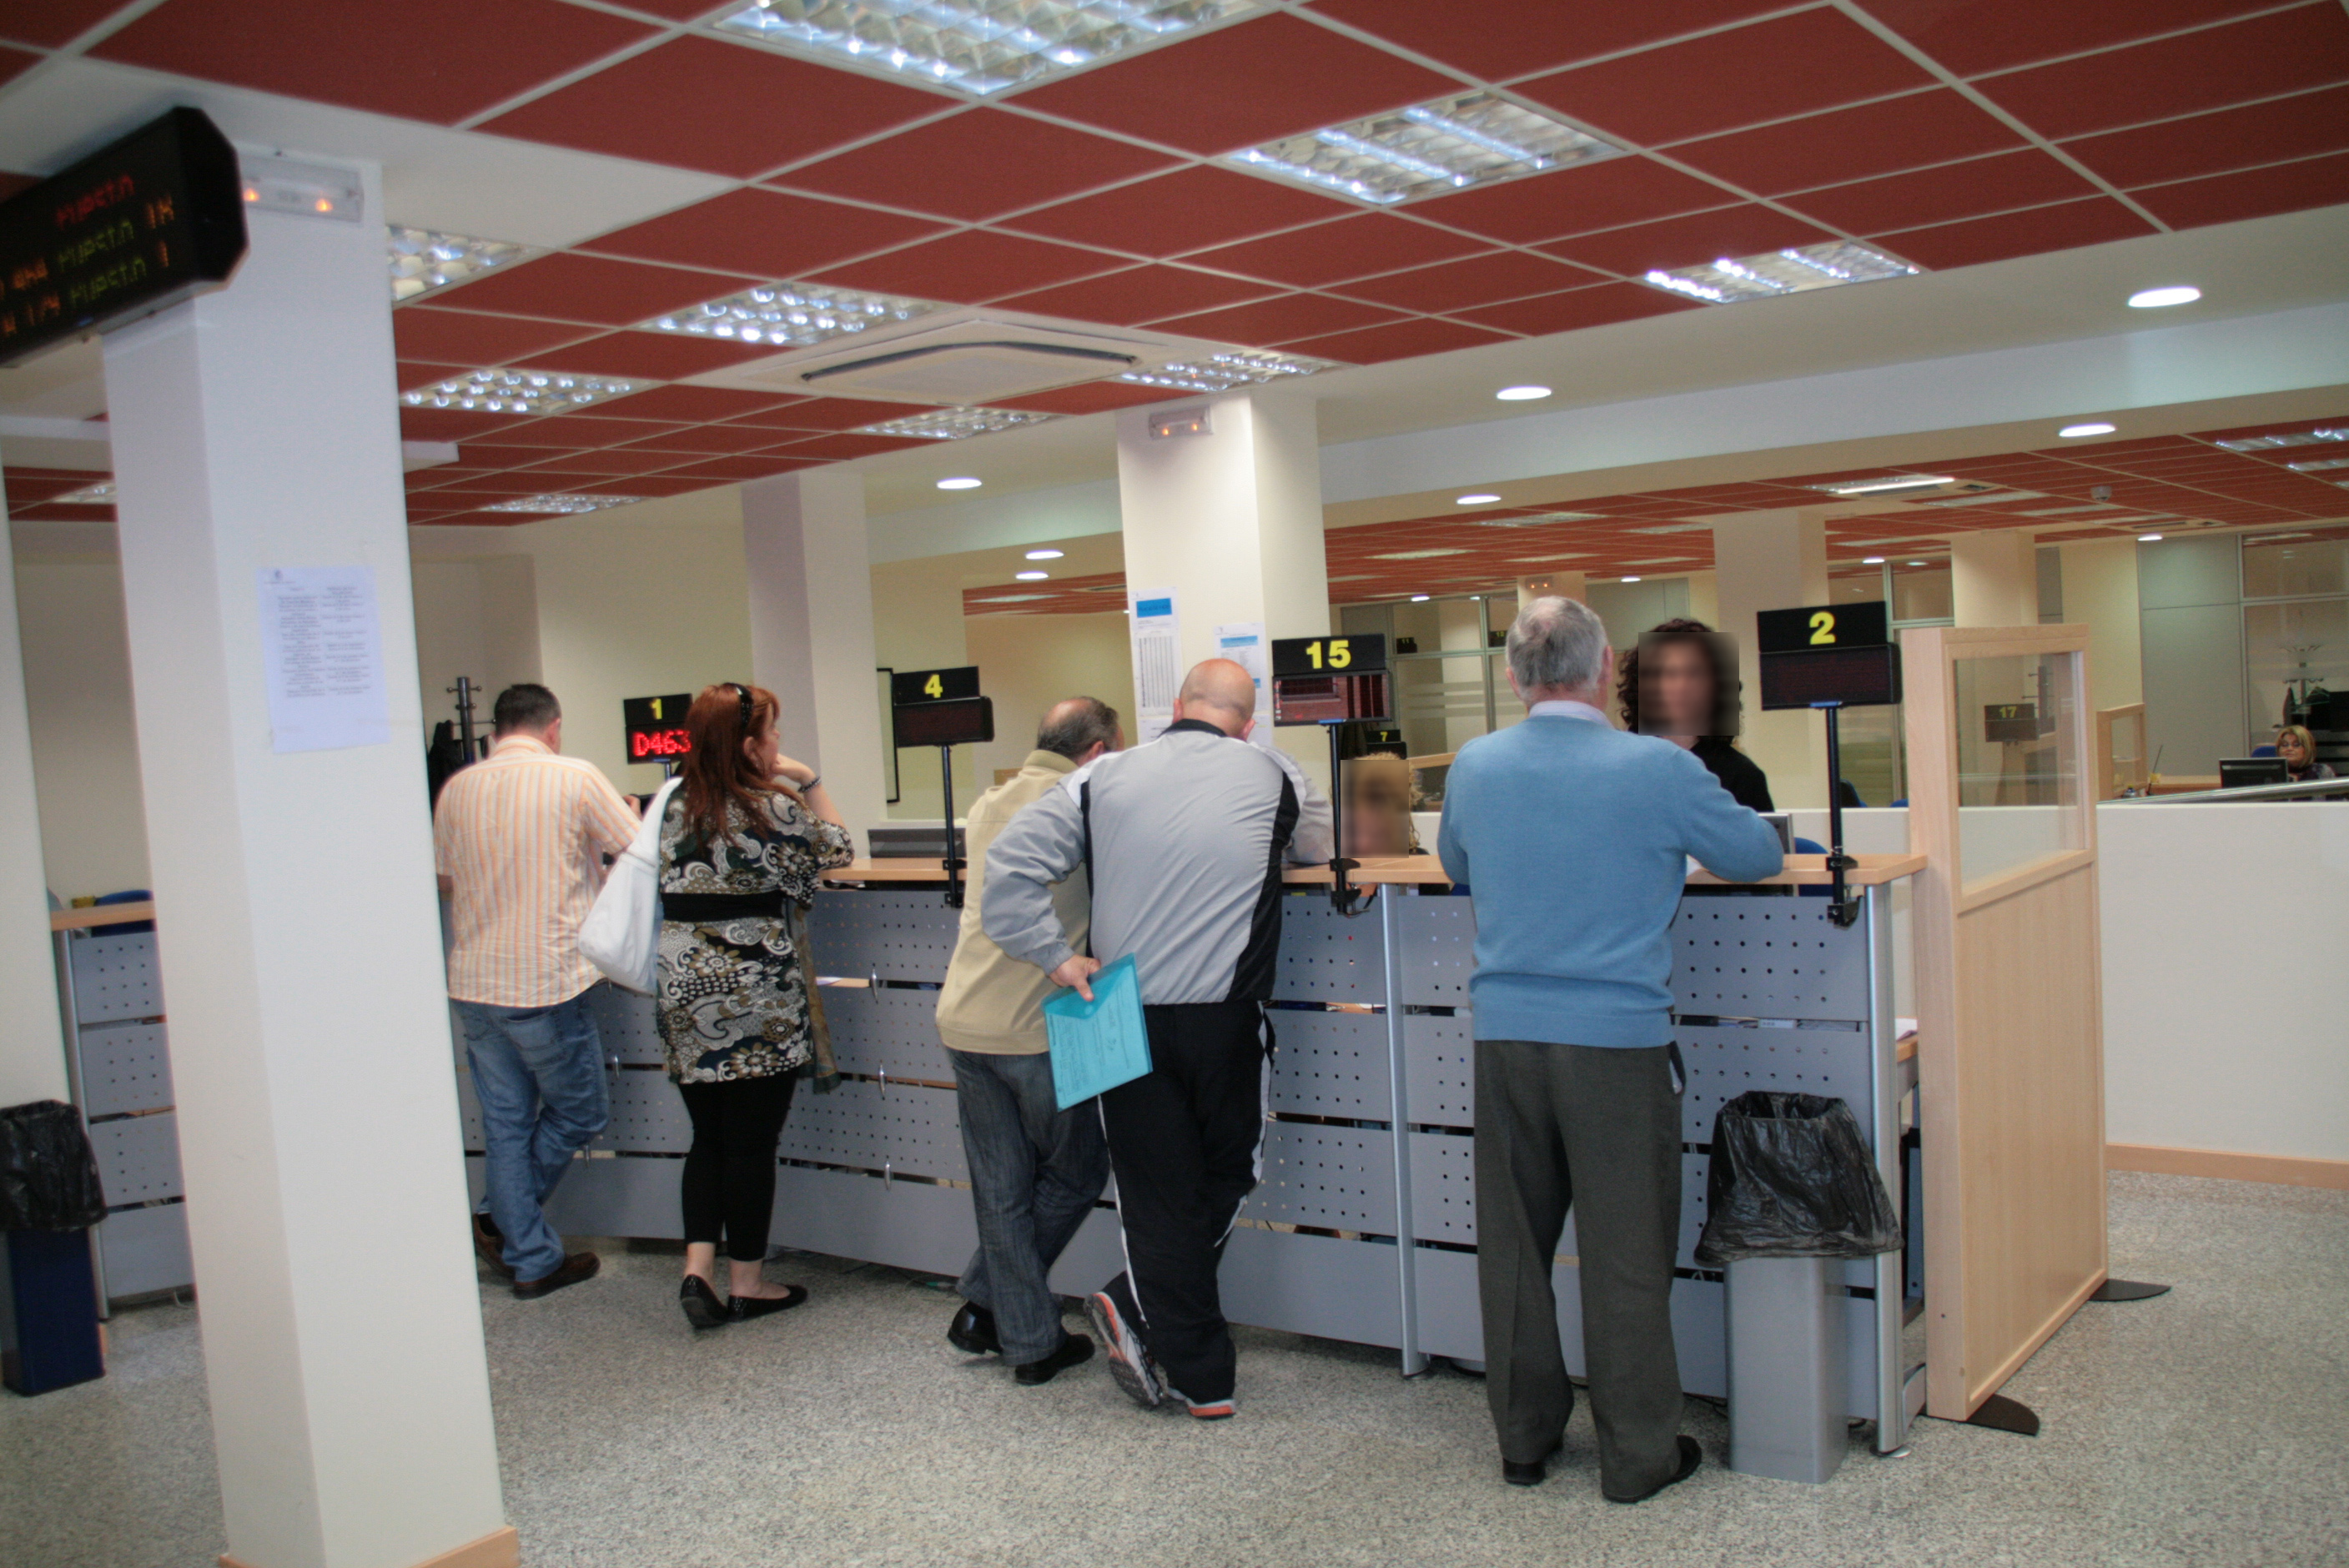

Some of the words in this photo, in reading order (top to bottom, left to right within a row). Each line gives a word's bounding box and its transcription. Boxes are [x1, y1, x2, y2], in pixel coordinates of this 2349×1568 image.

[1808, 611, 1837, 646] 2
[1305, 640, 1351, 669] 15
[923, 674, 943, 699] 4
[650, 698, 663, 720] 1
[1999, 706, 2017, 718] 17
[633, 728, 692, 757] D463
[1380, 731, 1388, 742] 7
